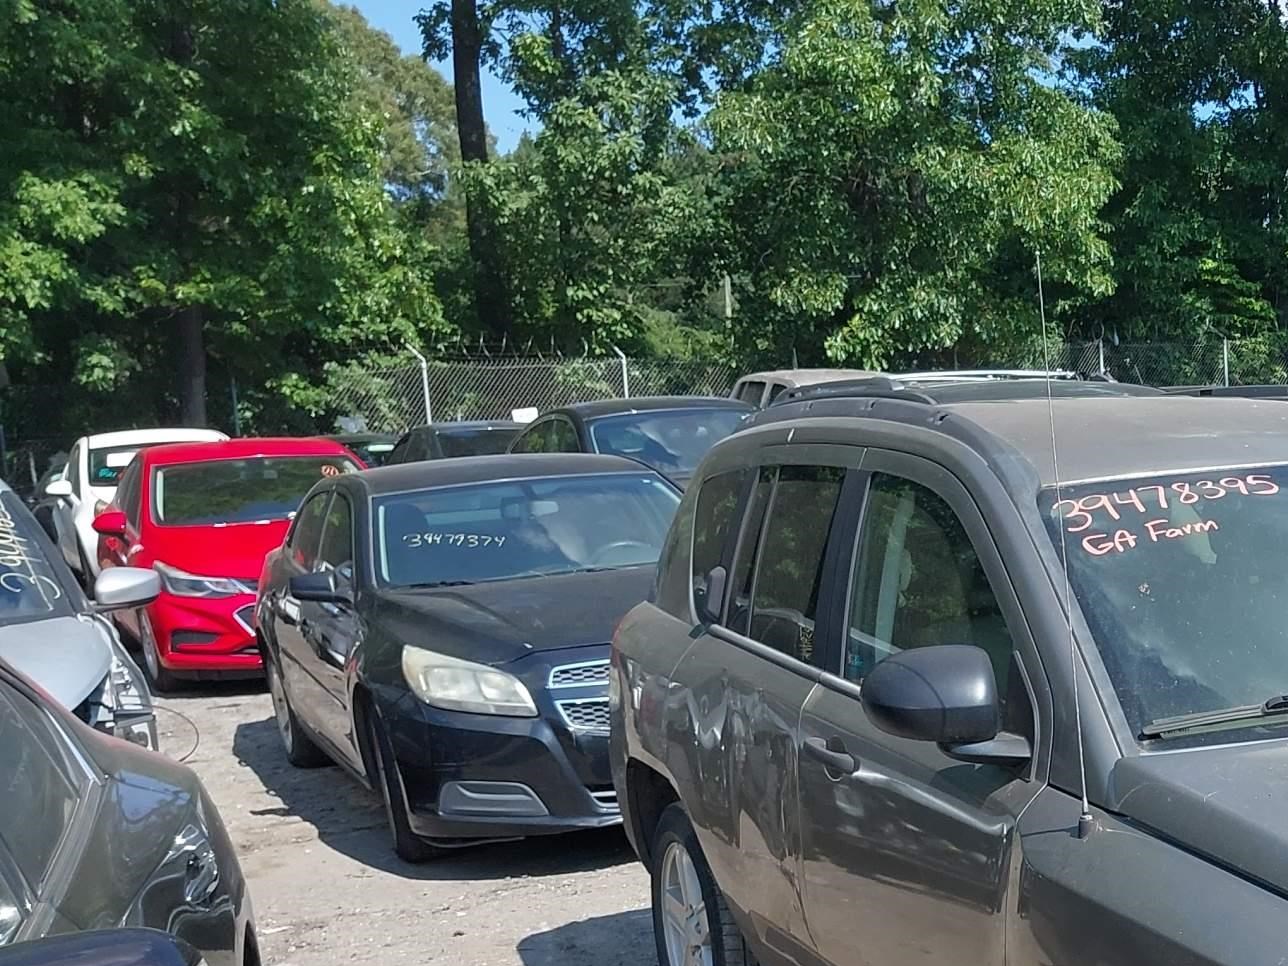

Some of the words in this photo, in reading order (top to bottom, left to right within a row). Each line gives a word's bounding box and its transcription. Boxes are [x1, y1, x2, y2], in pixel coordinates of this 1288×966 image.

[1052, 475, 1279, 532] 39478395
[1082, 529, 1137, 556] GA
[1144, 519, 1219, 542] Farm
